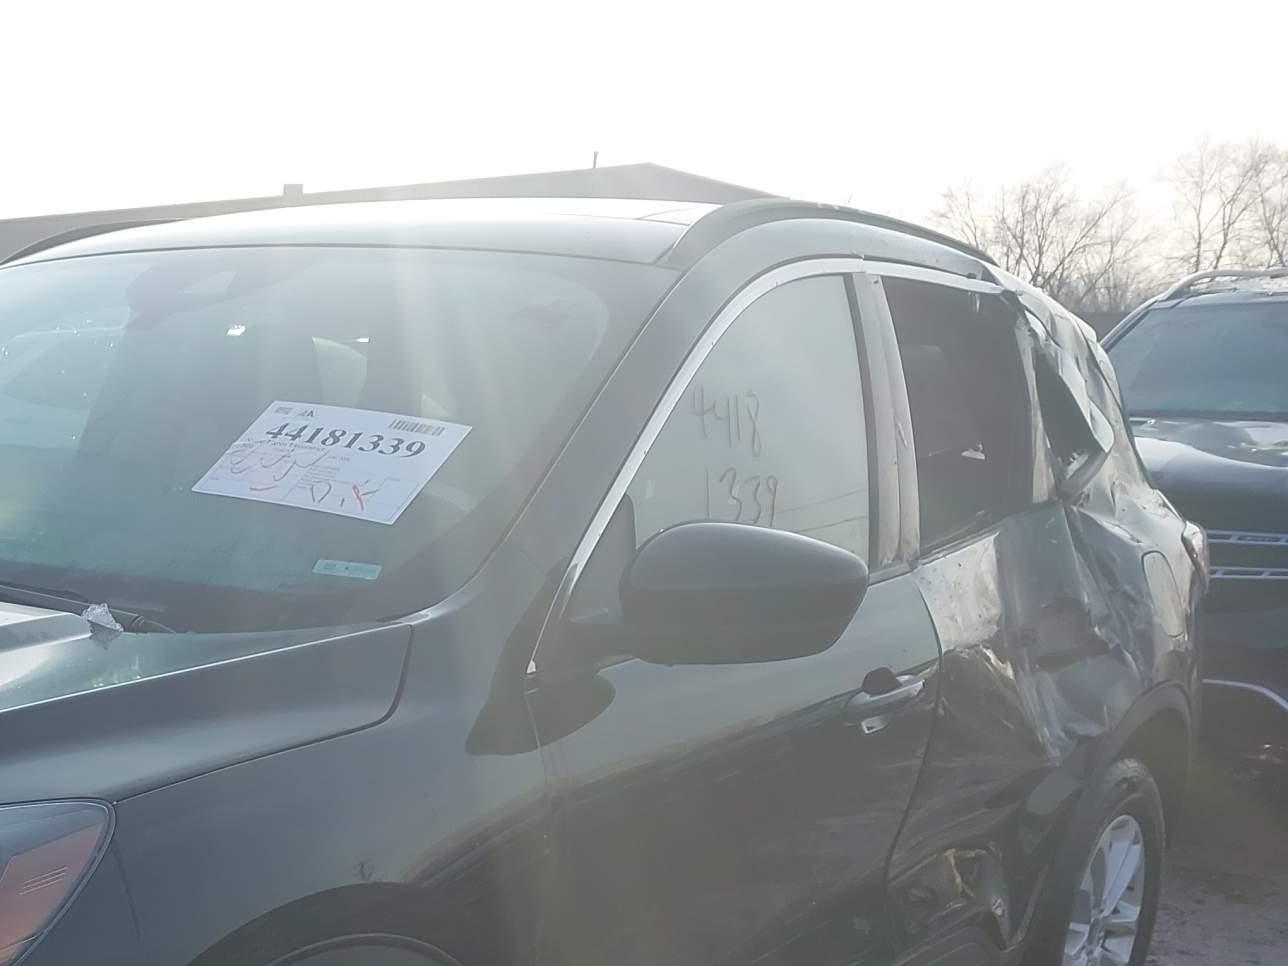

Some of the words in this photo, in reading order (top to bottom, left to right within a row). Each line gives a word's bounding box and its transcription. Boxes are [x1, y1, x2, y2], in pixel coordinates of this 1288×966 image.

[265, 420, 427, 459] 44181339
[692, 384, 763, 458] 4418
[705, 466, 779, 528] 1339
